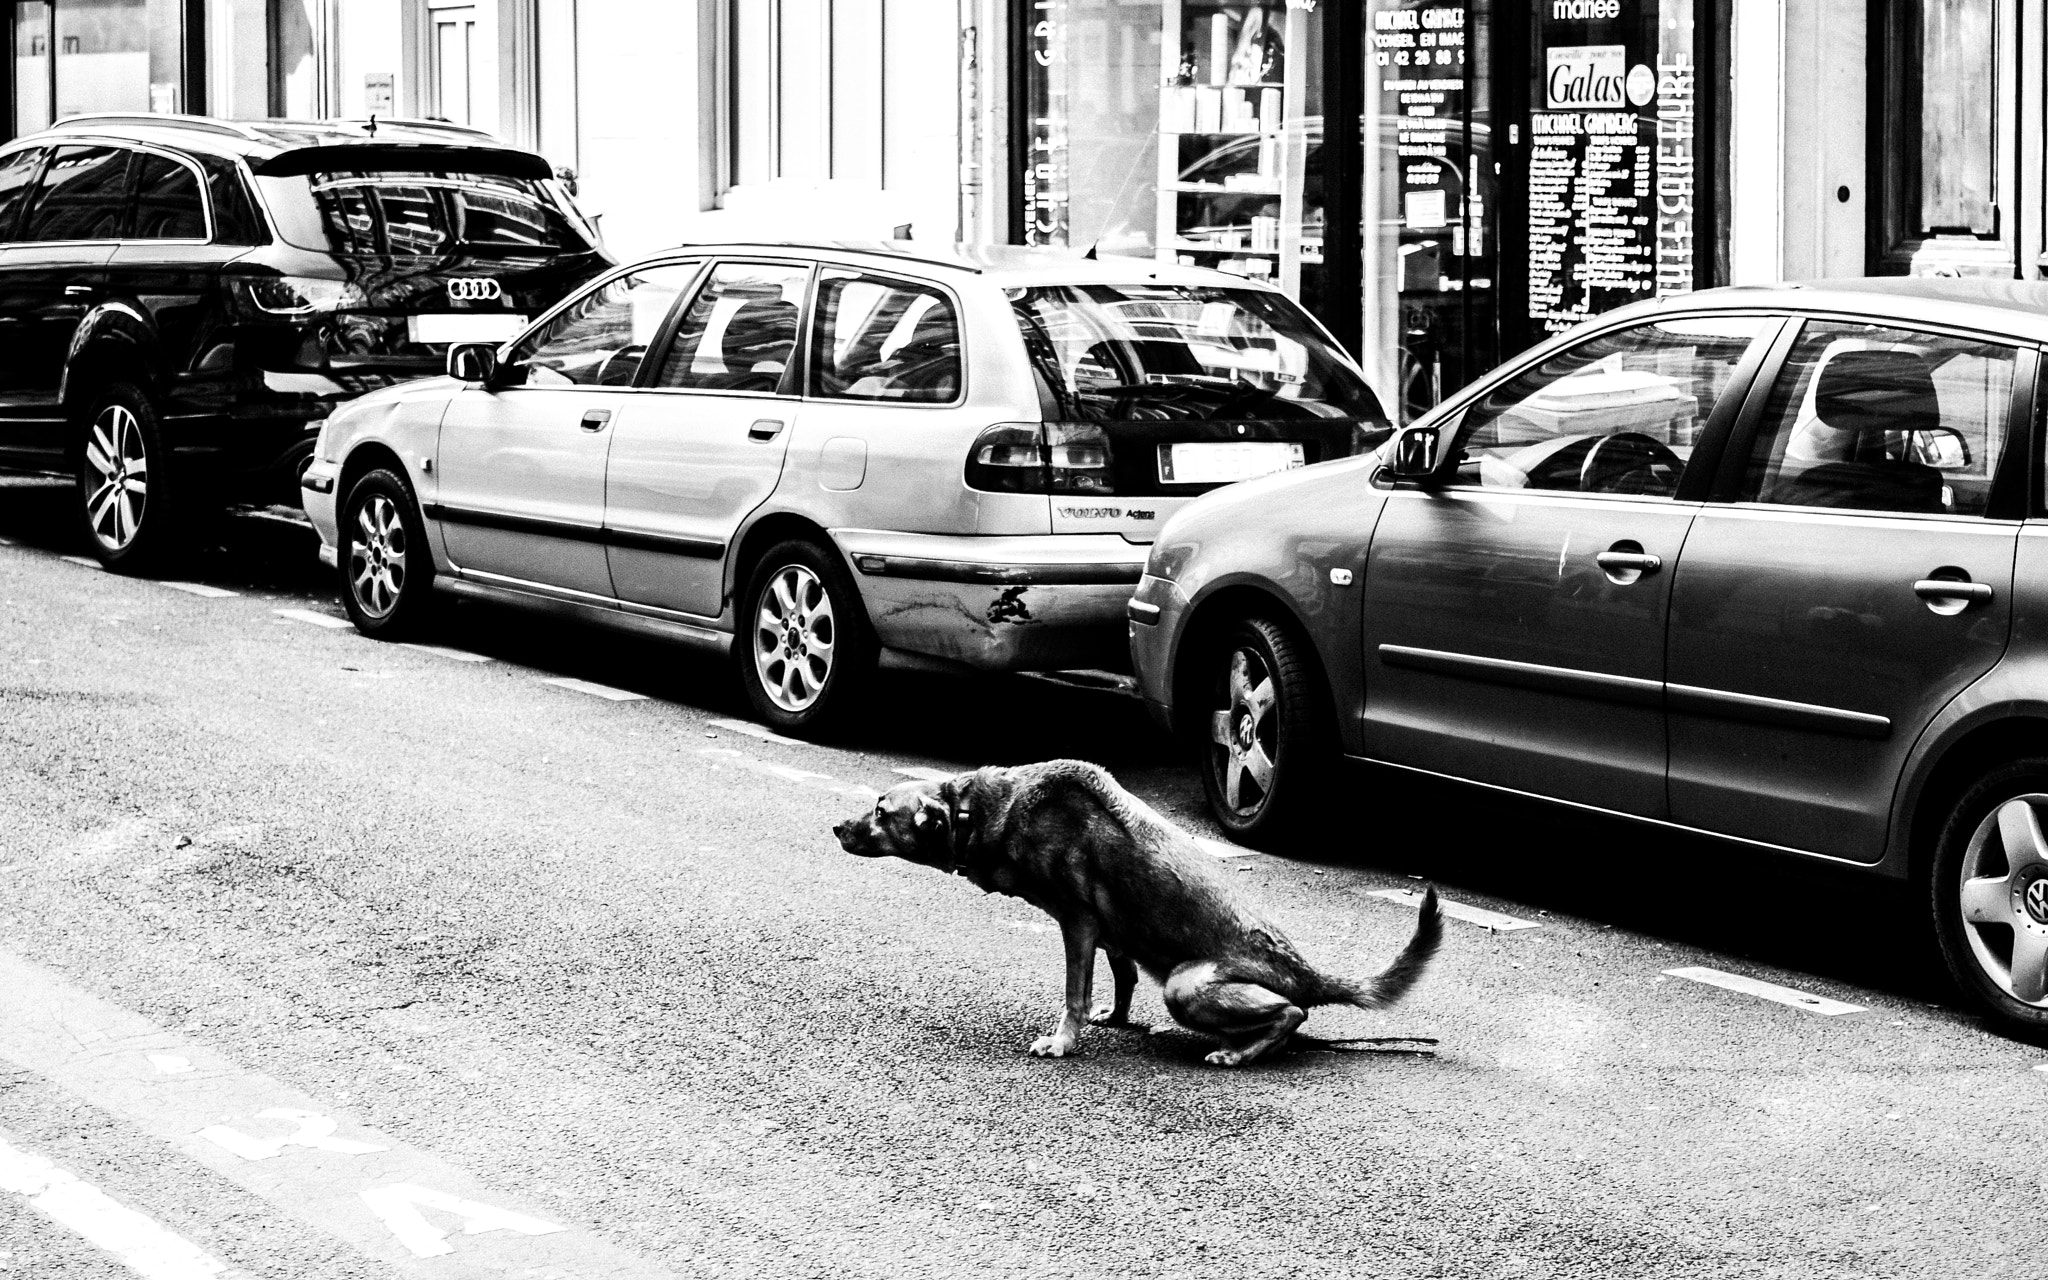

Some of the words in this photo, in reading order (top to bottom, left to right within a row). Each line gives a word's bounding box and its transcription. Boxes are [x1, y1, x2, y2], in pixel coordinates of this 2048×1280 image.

[1420, 33, 1436, 46] EN
[1549, 63, 1623, 104] Galas
[1532, 114, 1584, 134] MICHAEL
[1657, 51, 1694, 215] COIFFURE
[1024, 169, 1036, 247] ATELIER
[1057, 507, 1122, 519] VOLVO
